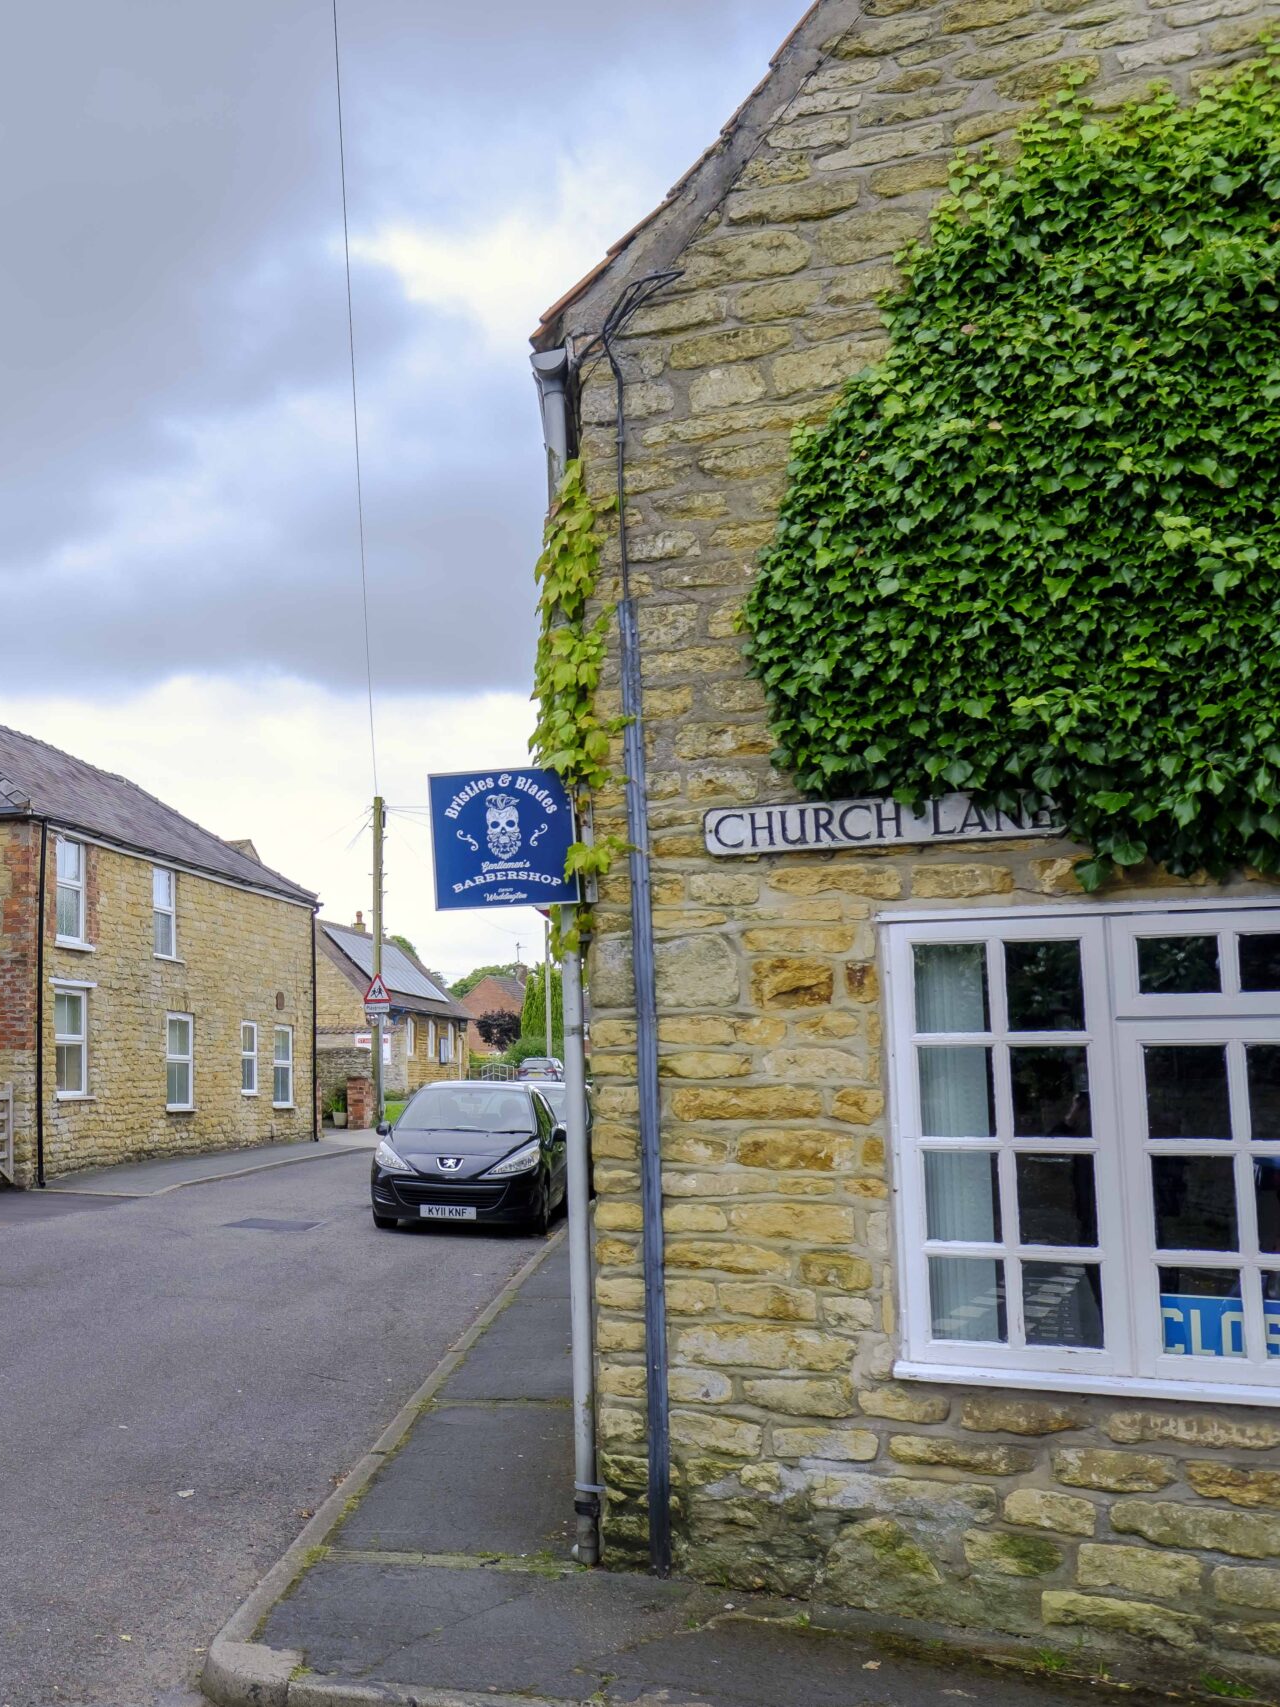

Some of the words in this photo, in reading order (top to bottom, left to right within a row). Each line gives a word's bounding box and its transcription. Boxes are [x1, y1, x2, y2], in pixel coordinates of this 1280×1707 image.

[444, 777, 495, 820] Bristles
[497, 773, 513, 787] &
[515, 775, 558, 814] Blades
[713, 802, 904, 848] CHURCH
[481, 859, 531, 873] Gentlemen's
[452, 870, 563, 894] BARBERSHOP
[427, 1206, 446, 1216] KY11
[448, 1207, 468, 1217] KNF
